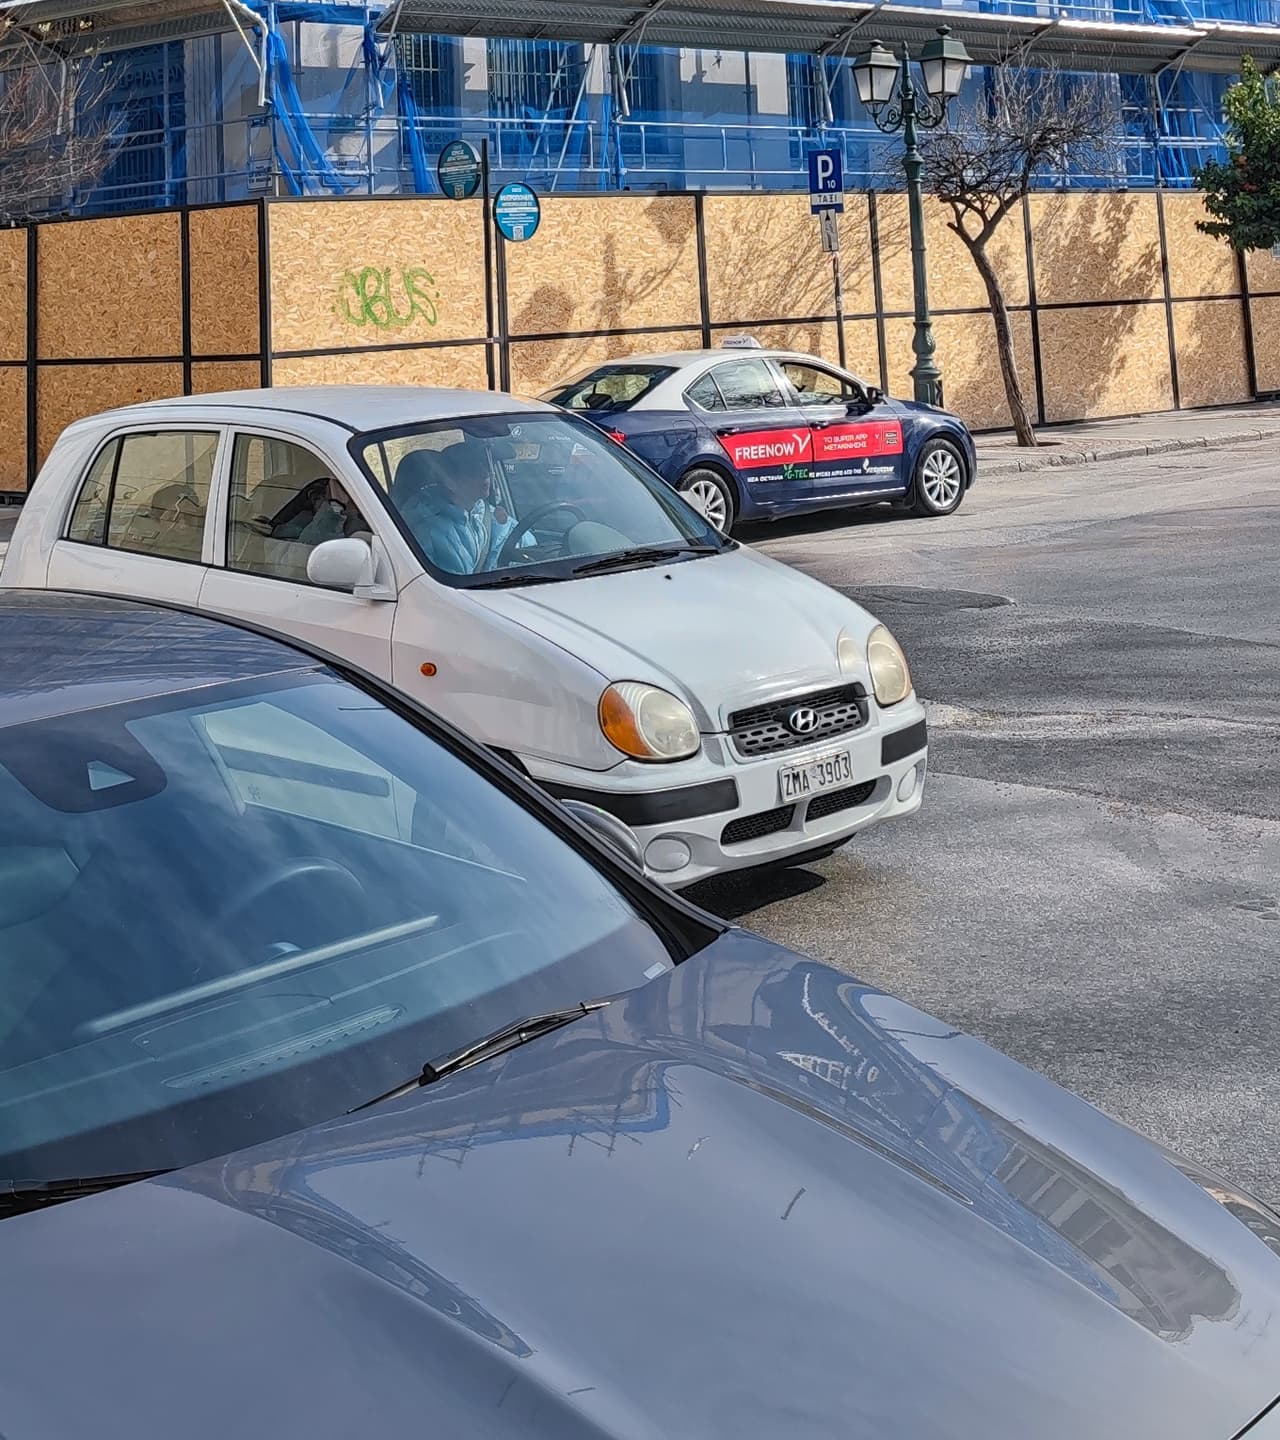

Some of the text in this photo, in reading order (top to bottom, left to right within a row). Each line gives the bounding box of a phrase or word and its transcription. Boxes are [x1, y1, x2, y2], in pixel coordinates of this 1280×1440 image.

[817, 155, 833, 189] P
[827, 180, 836, 189] 10
[735, 442, 795, 461] FREENOW
[784, 757, 850, 796] ZMA 3903
